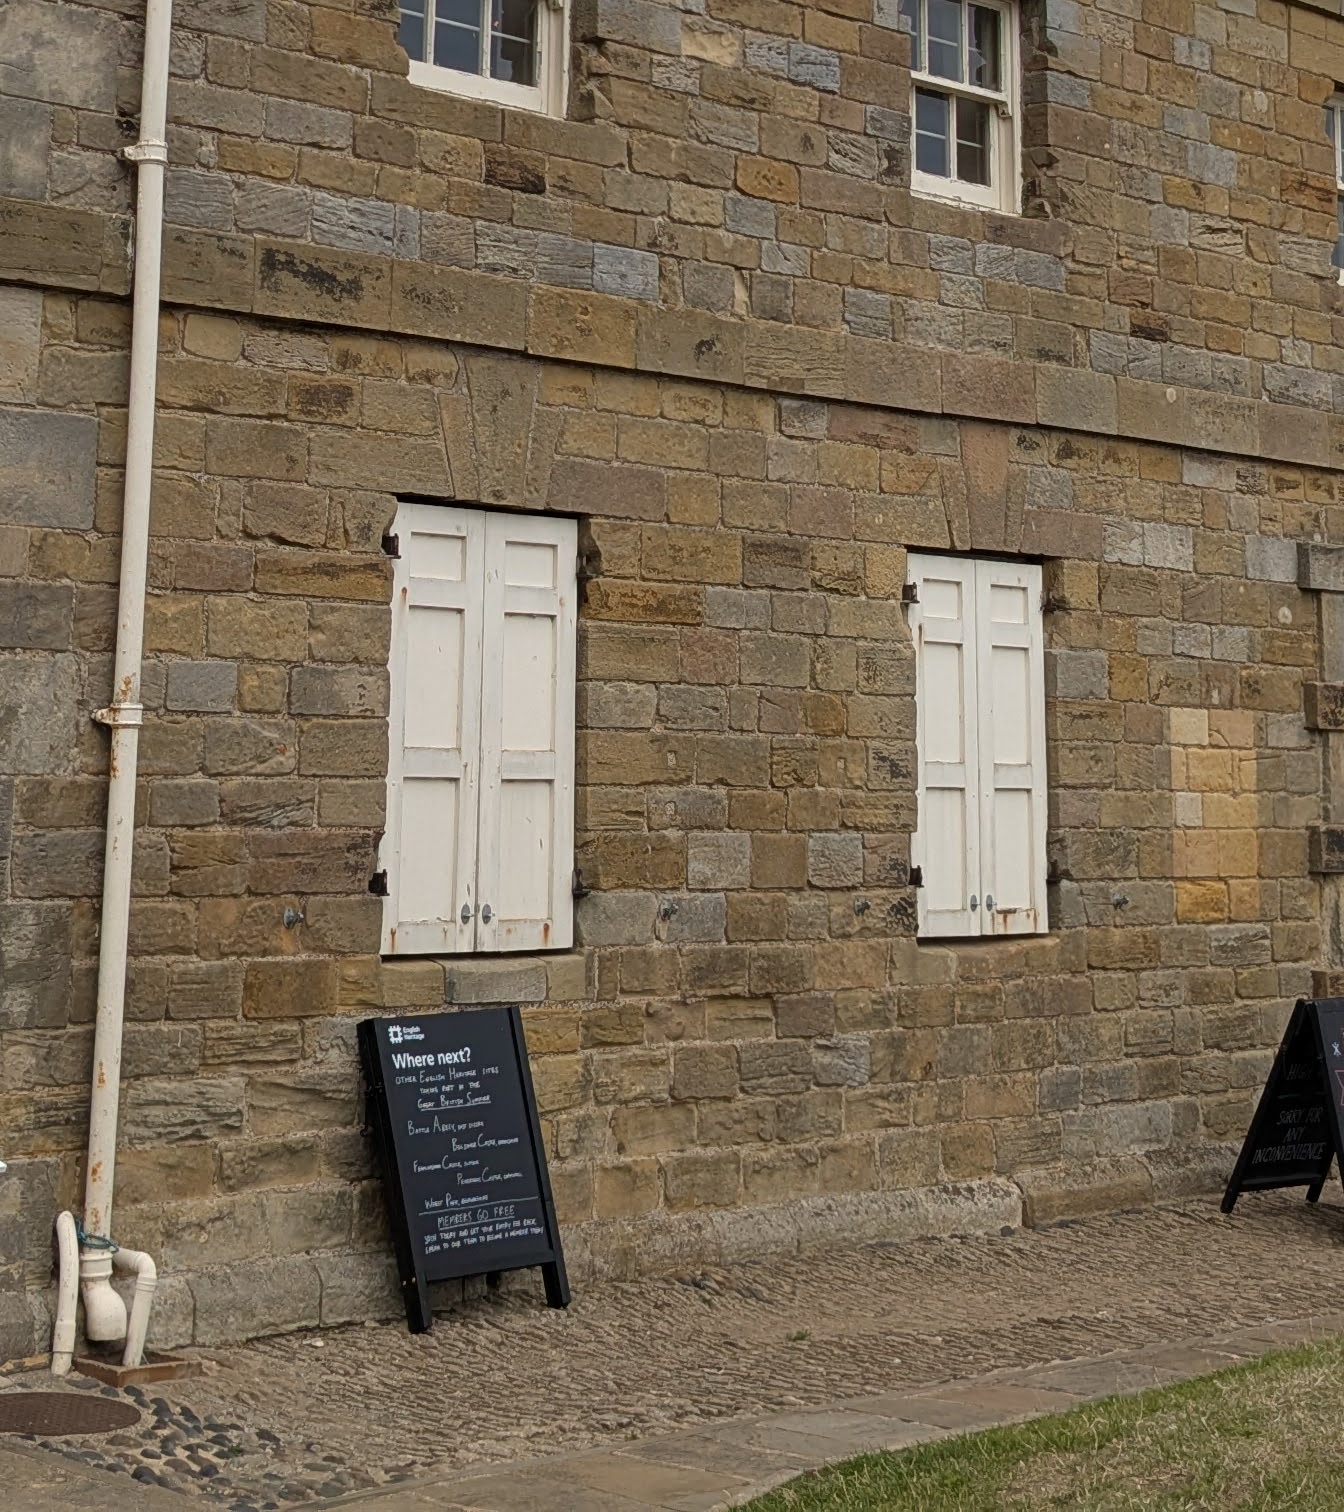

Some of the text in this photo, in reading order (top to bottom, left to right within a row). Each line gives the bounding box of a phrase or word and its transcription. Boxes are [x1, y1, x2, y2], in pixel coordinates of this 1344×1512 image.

[392, 1046, 471, 1069] Where next?
[1252, 1142, 1327, 1165] INCONVENIENCE
[438, 1205, 515, 1228] MEMBERS GO FREE
